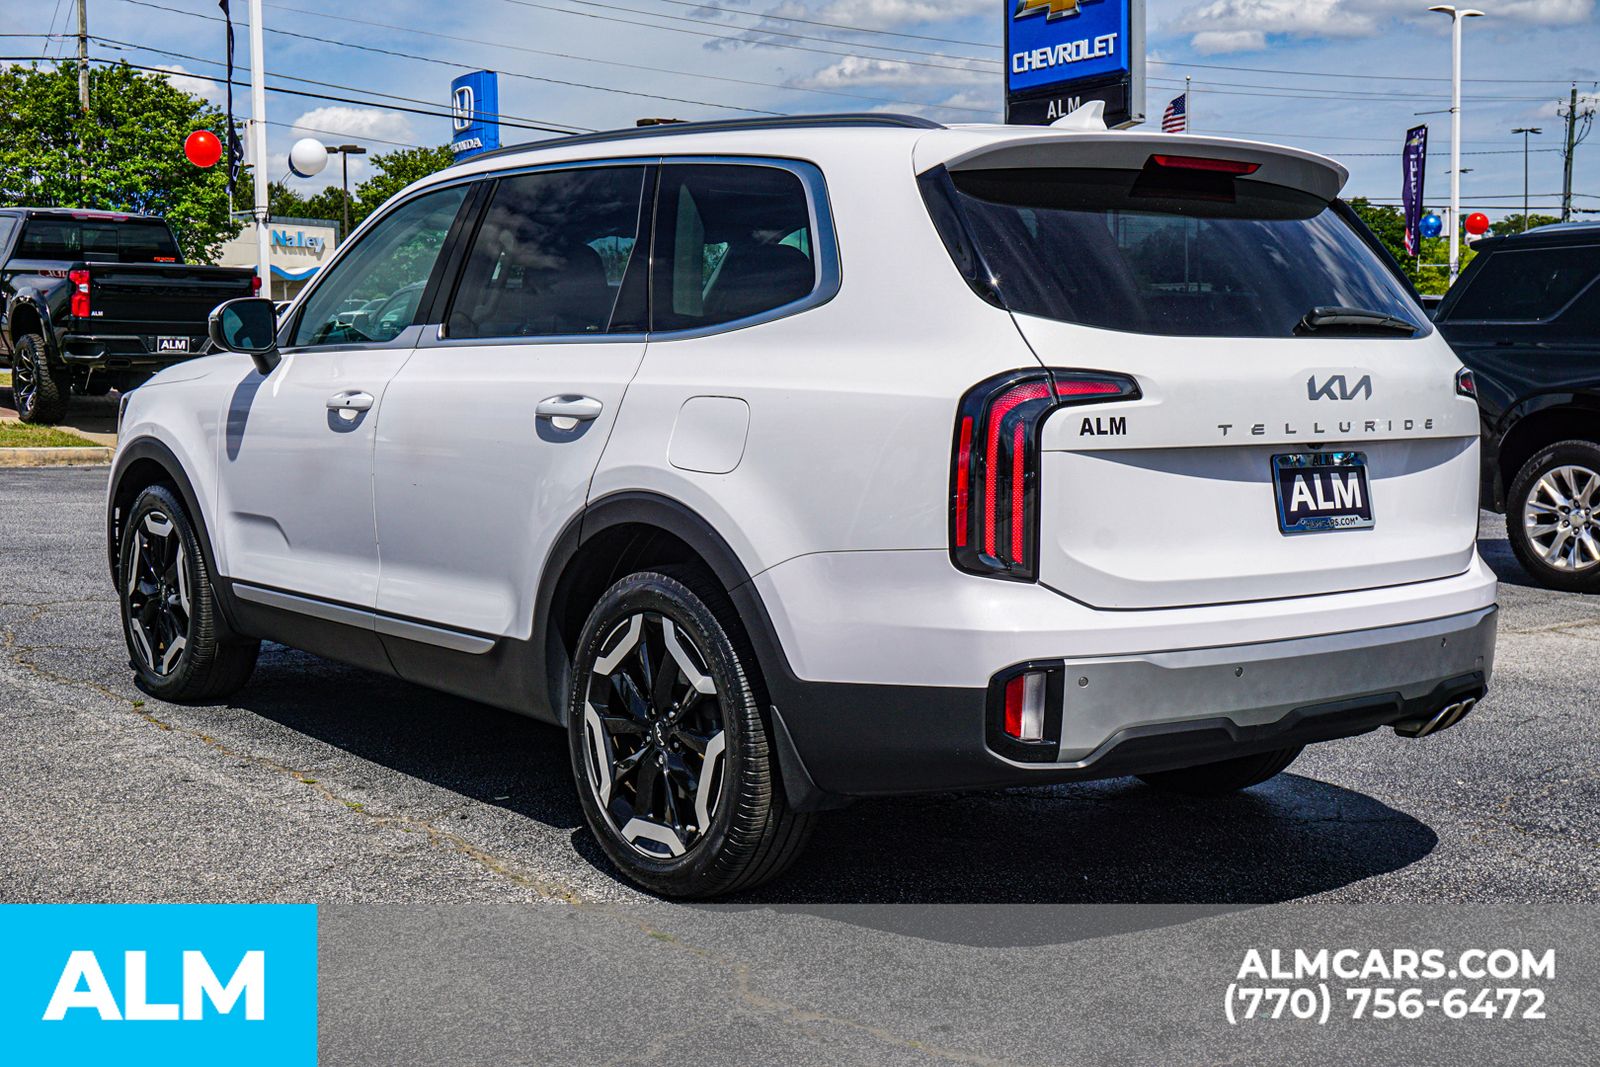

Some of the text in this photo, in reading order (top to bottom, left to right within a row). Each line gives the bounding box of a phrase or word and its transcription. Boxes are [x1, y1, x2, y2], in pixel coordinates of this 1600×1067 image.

[1012, 32, 1118, 74] CHEVROLET
[1047, 96, 1081, 119] ALM
[272, 229, 325, 253] Nalley
[160, 339, 186, 350] ALM
[1306, 374, 1373, 401] KIA
[1079, 416, 1127, 436] ALM
[1217, 417, 1434, 437] TELLURIDE
[1289, 471, 1363, 512] ALM
